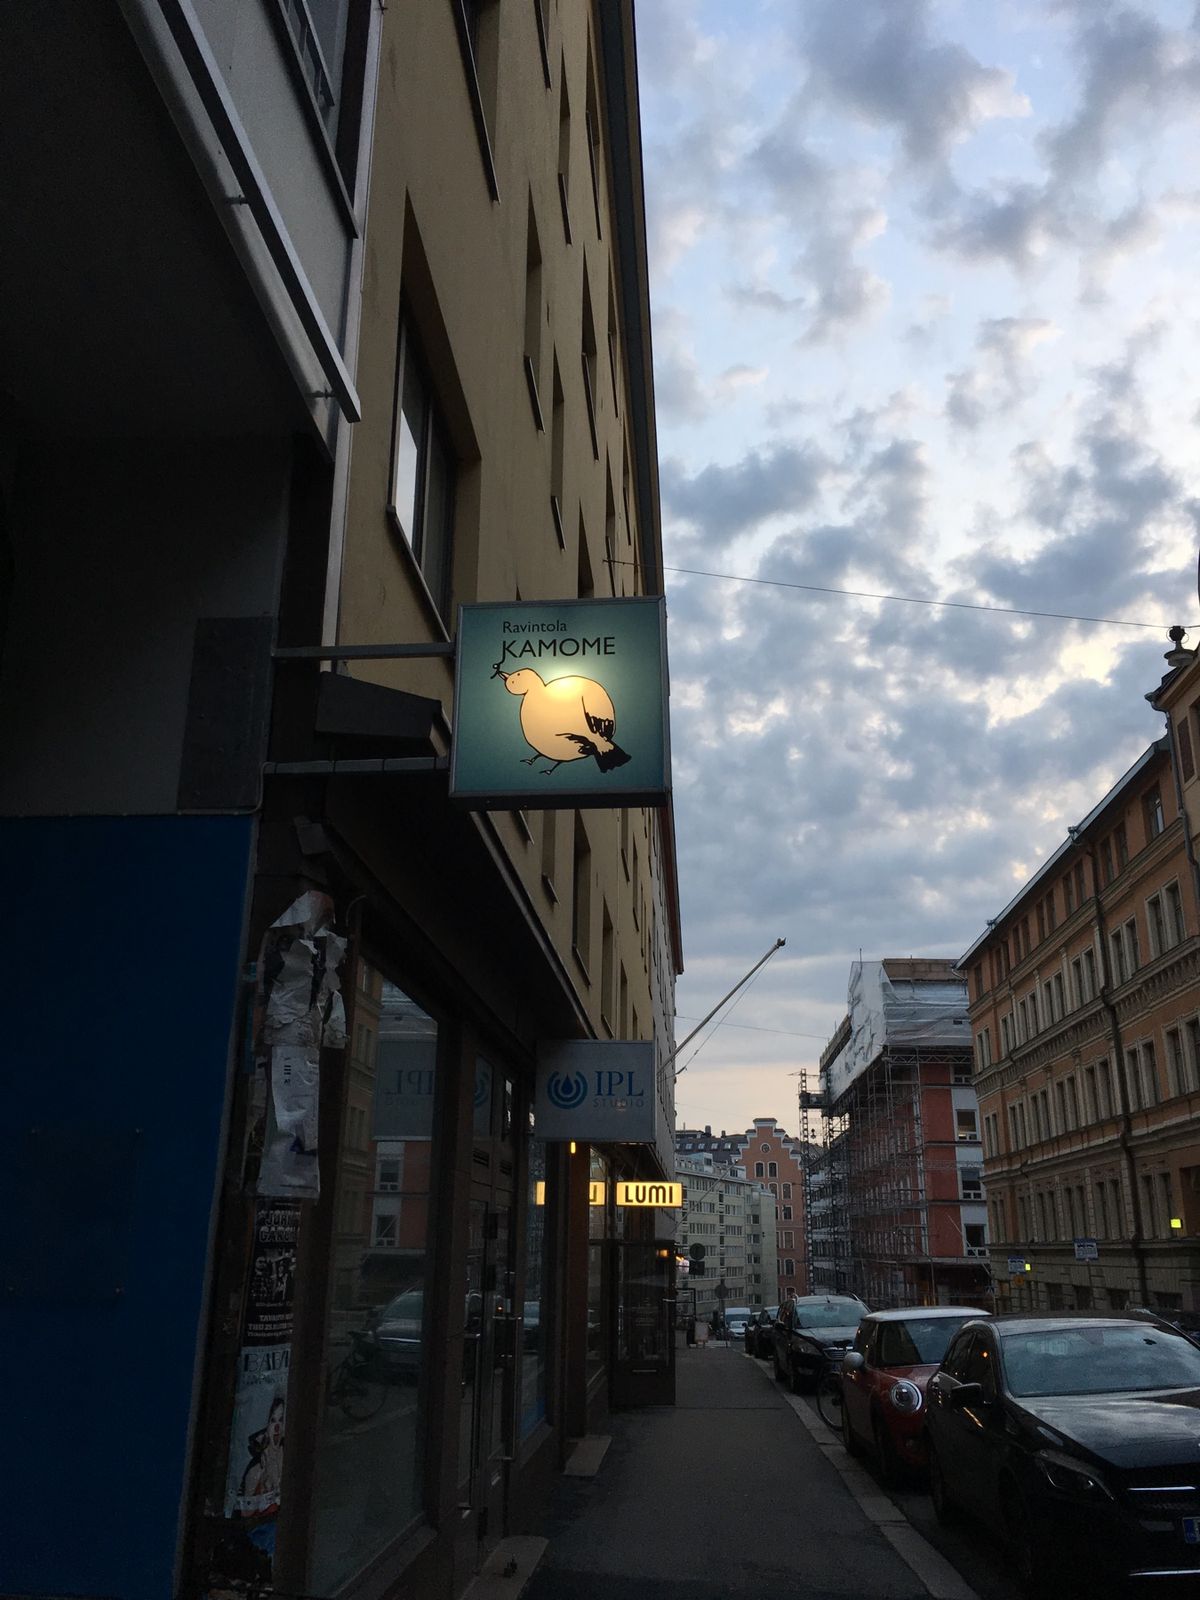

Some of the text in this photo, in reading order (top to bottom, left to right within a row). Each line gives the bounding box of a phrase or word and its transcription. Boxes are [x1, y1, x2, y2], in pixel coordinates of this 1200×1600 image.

[502, 620, 567, 634] Ravintola
[501, 636, 616, 660] KAMOME
[594, 1070, 645, 1097] IPL
[624, 1184, 674, 1204] LUMI
